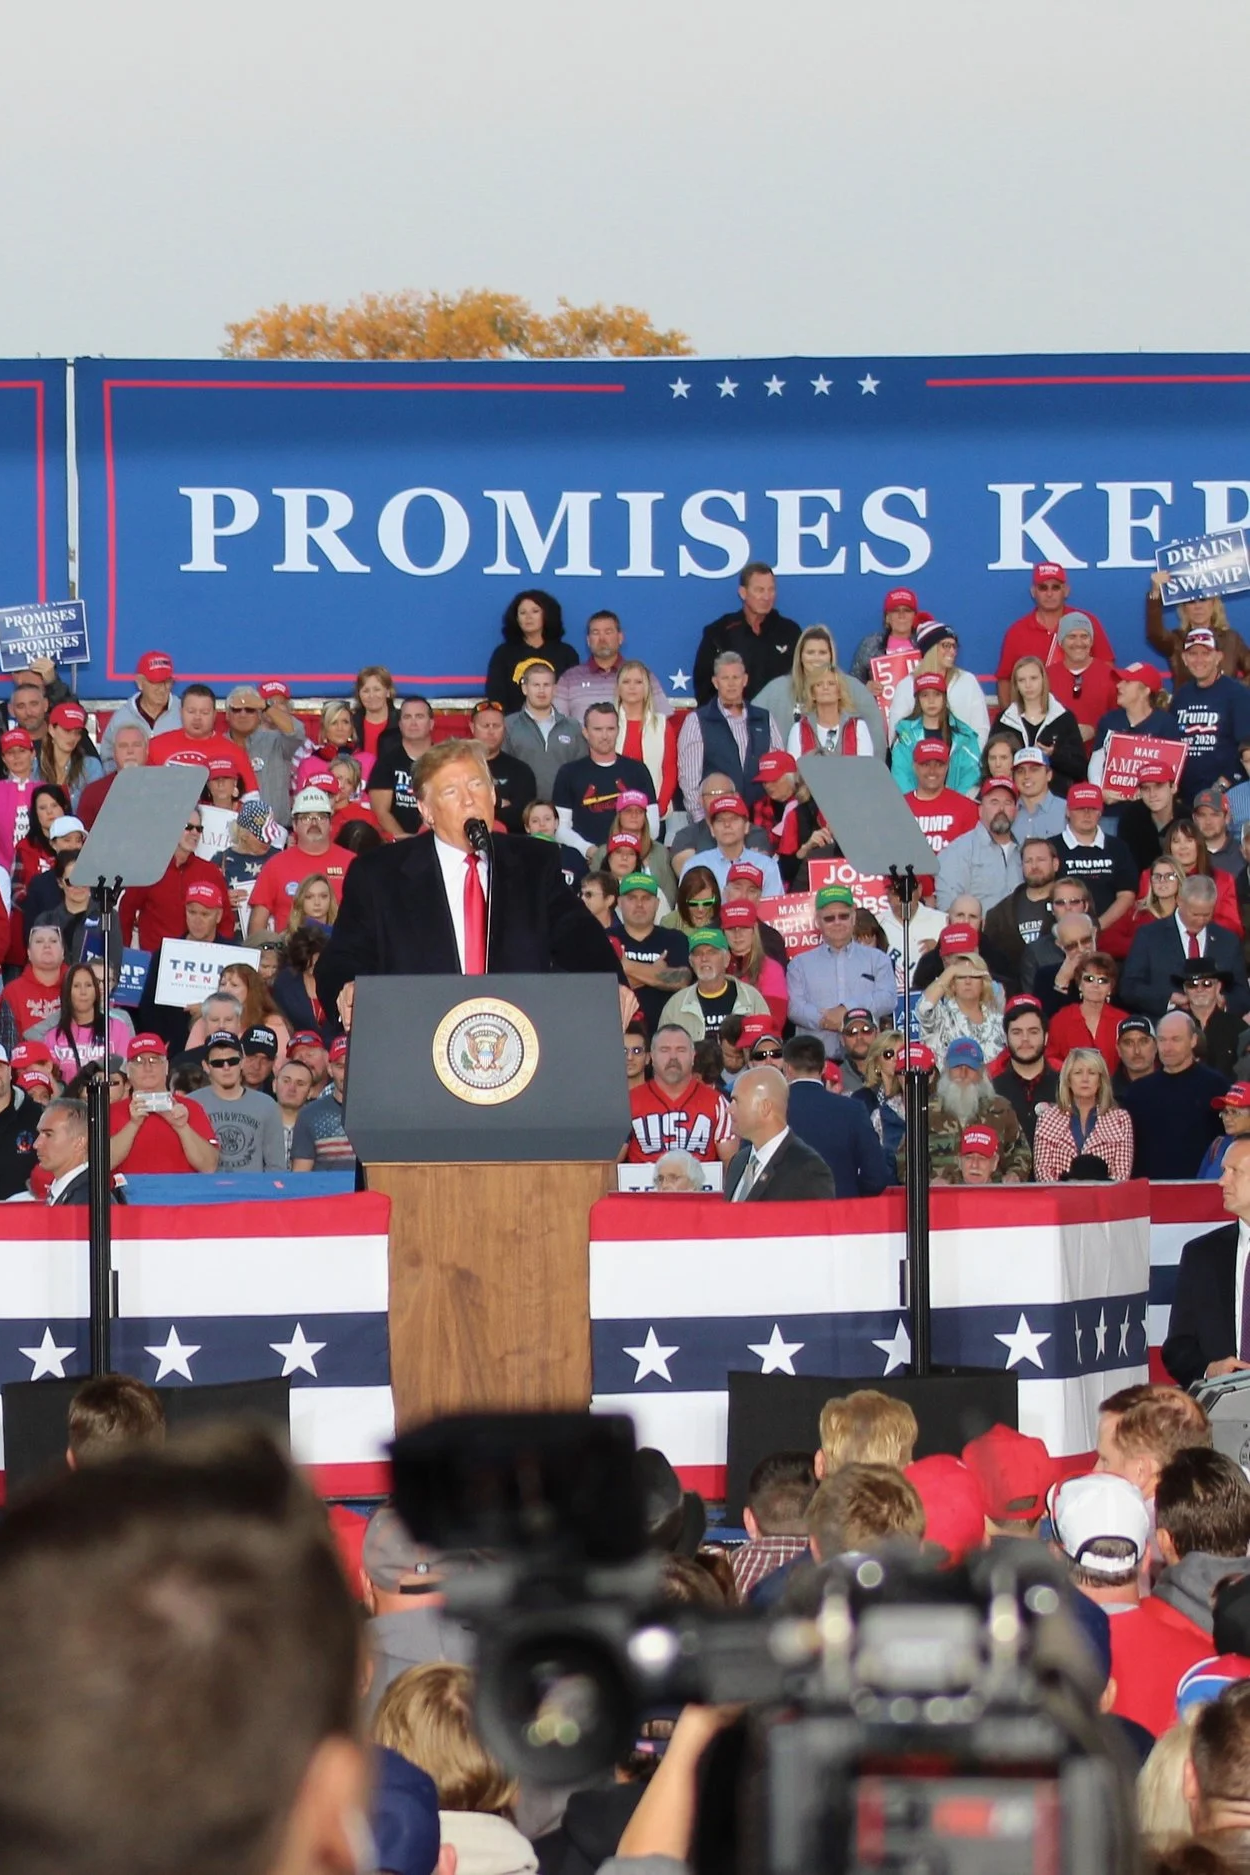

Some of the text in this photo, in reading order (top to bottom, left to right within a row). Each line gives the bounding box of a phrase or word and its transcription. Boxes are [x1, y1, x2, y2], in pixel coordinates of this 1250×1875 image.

[179, 487, 933, 580] PROMISES
[1167, 536, 1233, 566] DRAIN
[1190, 559, 1214, 574] THE
[1166, 565, 1243, 596] SWAMP
[4, 608, 77, 629] PROMISES
[21, 622, 63, 637] MADE
[8, 635, 79, 655] PROMISES
[1177, 709, 1218, 726] Trump
[1194, 735, 1216, 745] 2020
[1134, 746, 1160, 760] MAKE
[1066, 859, 1112, 869] TRUMP
[778, 903, 809, 916] MAKE
[631, 1110, 712, 1155] USA
